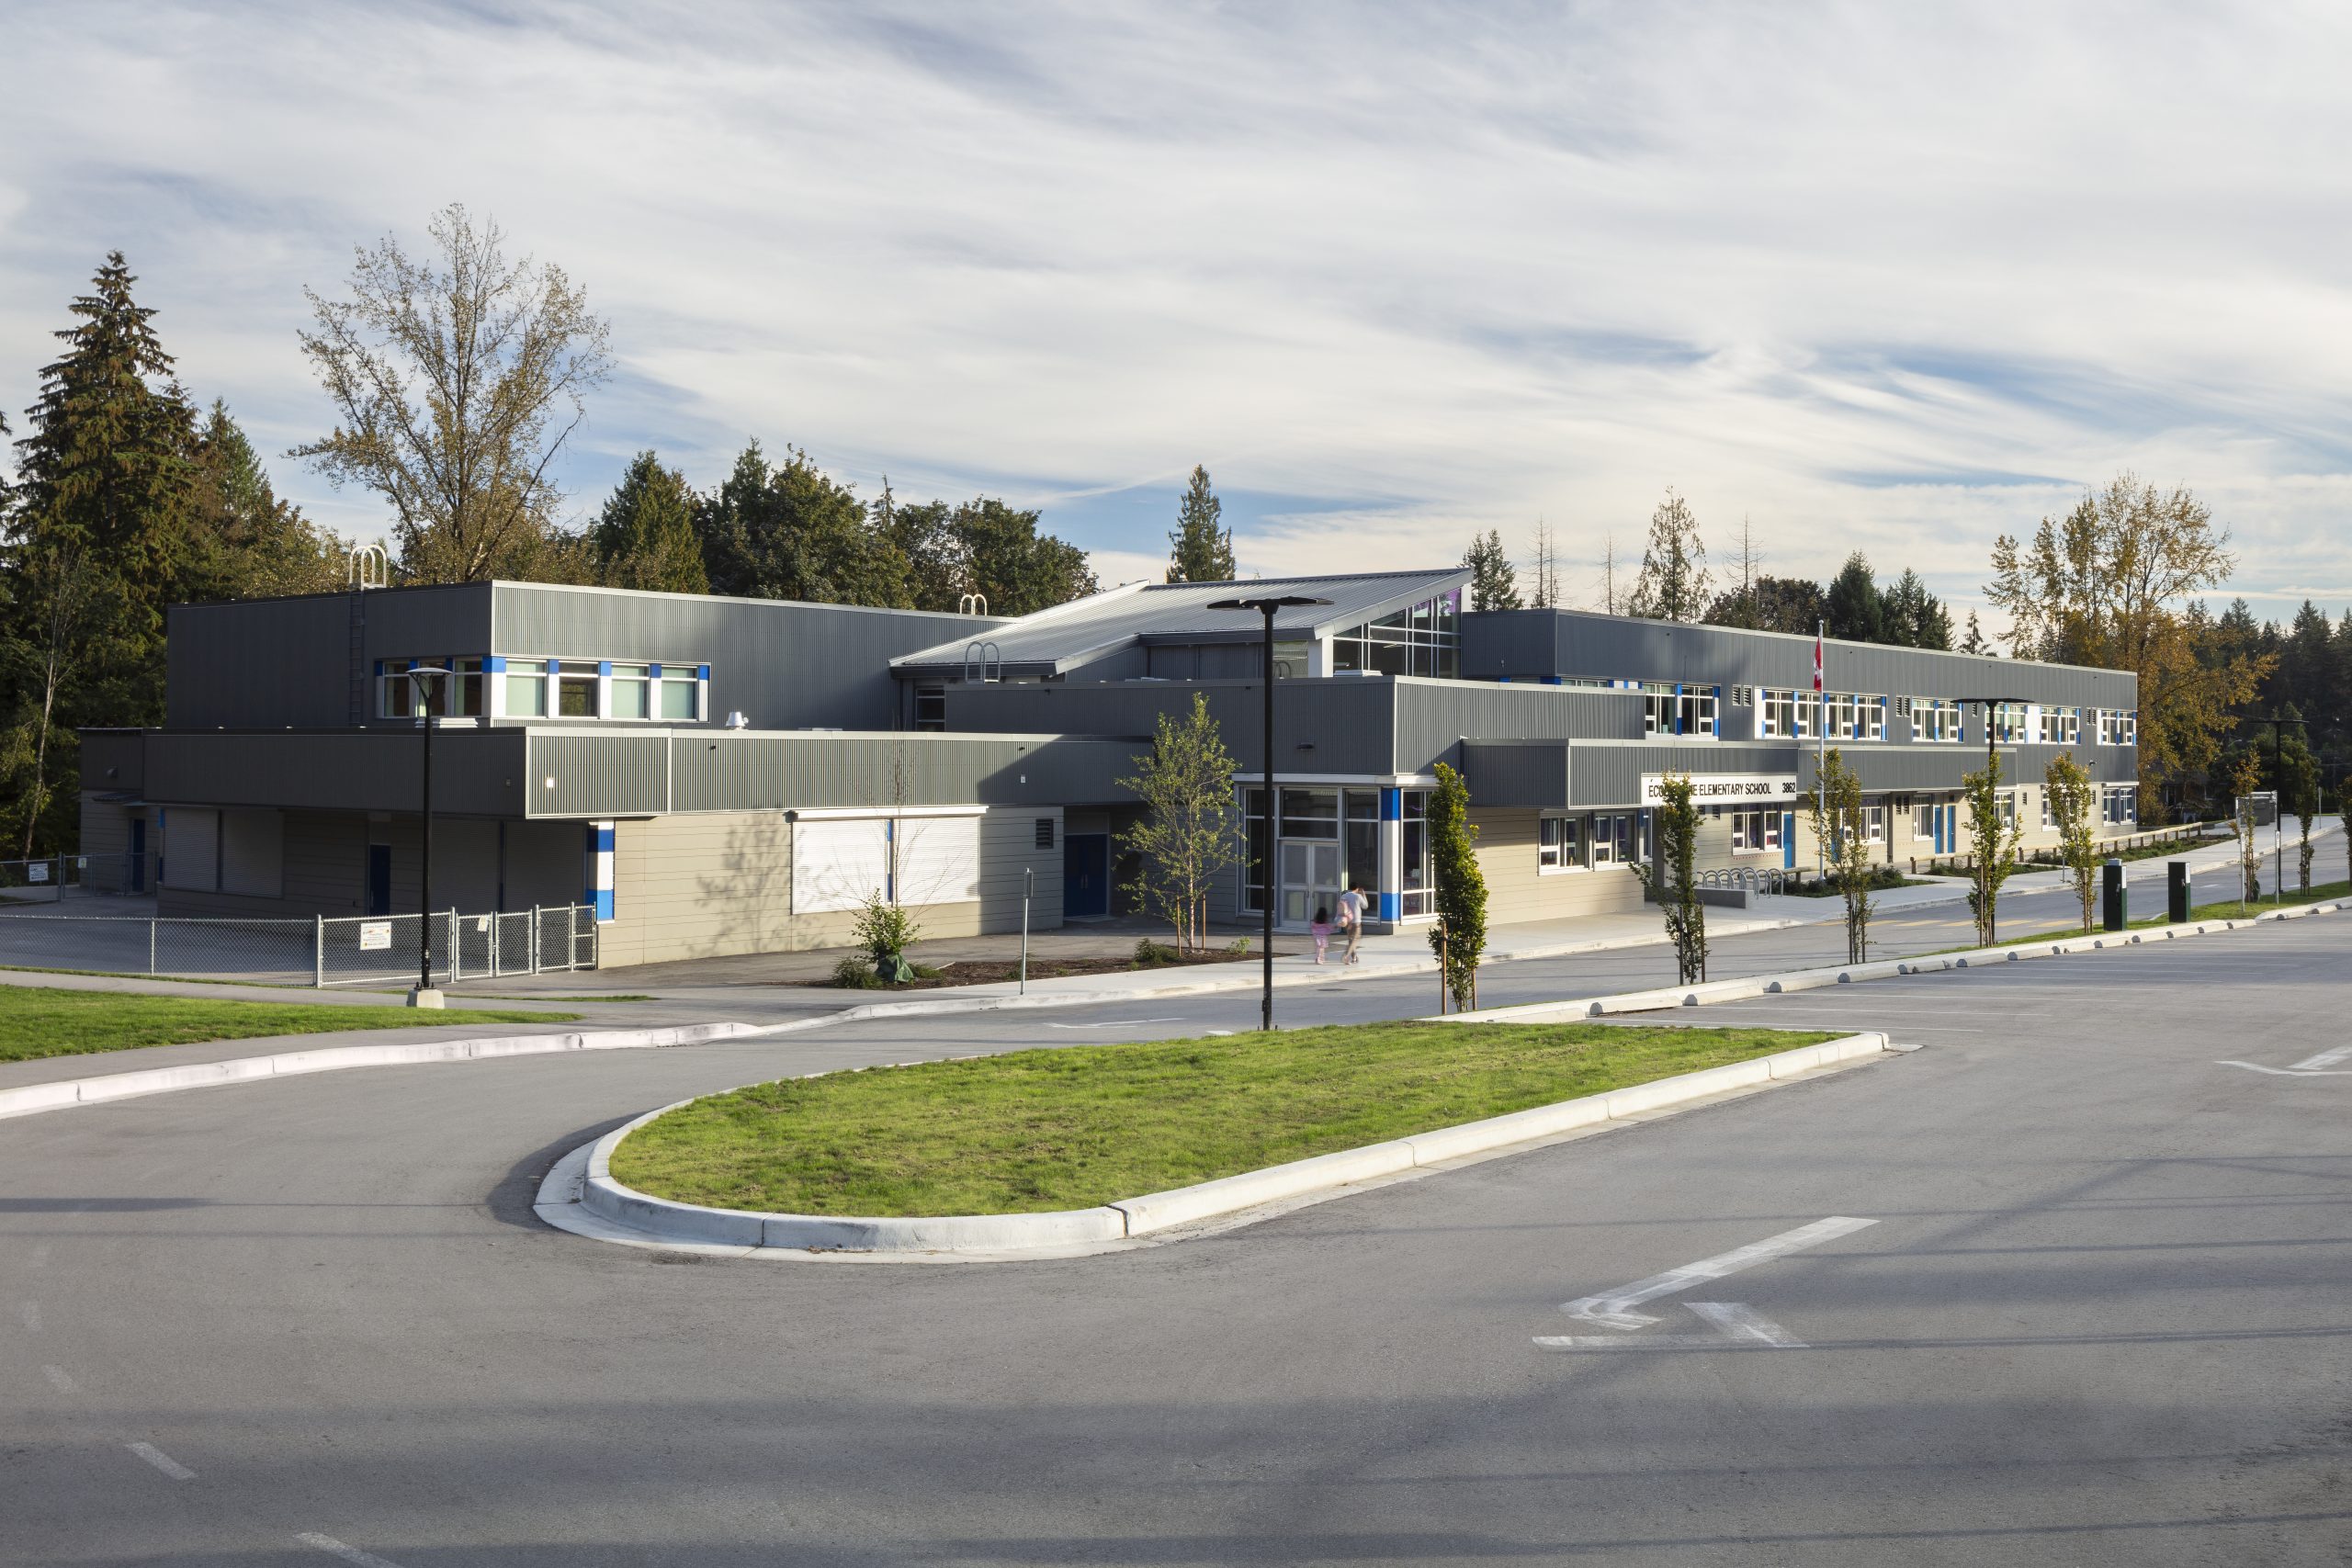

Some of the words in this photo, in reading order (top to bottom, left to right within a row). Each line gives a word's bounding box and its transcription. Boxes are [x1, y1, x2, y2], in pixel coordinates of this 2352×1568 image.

[1700, 784, 1744, 795] ELEMENTARY
[1746, 783, 1771, 795] SCHOOL
[1782, 782, 1796, 793] 3862
